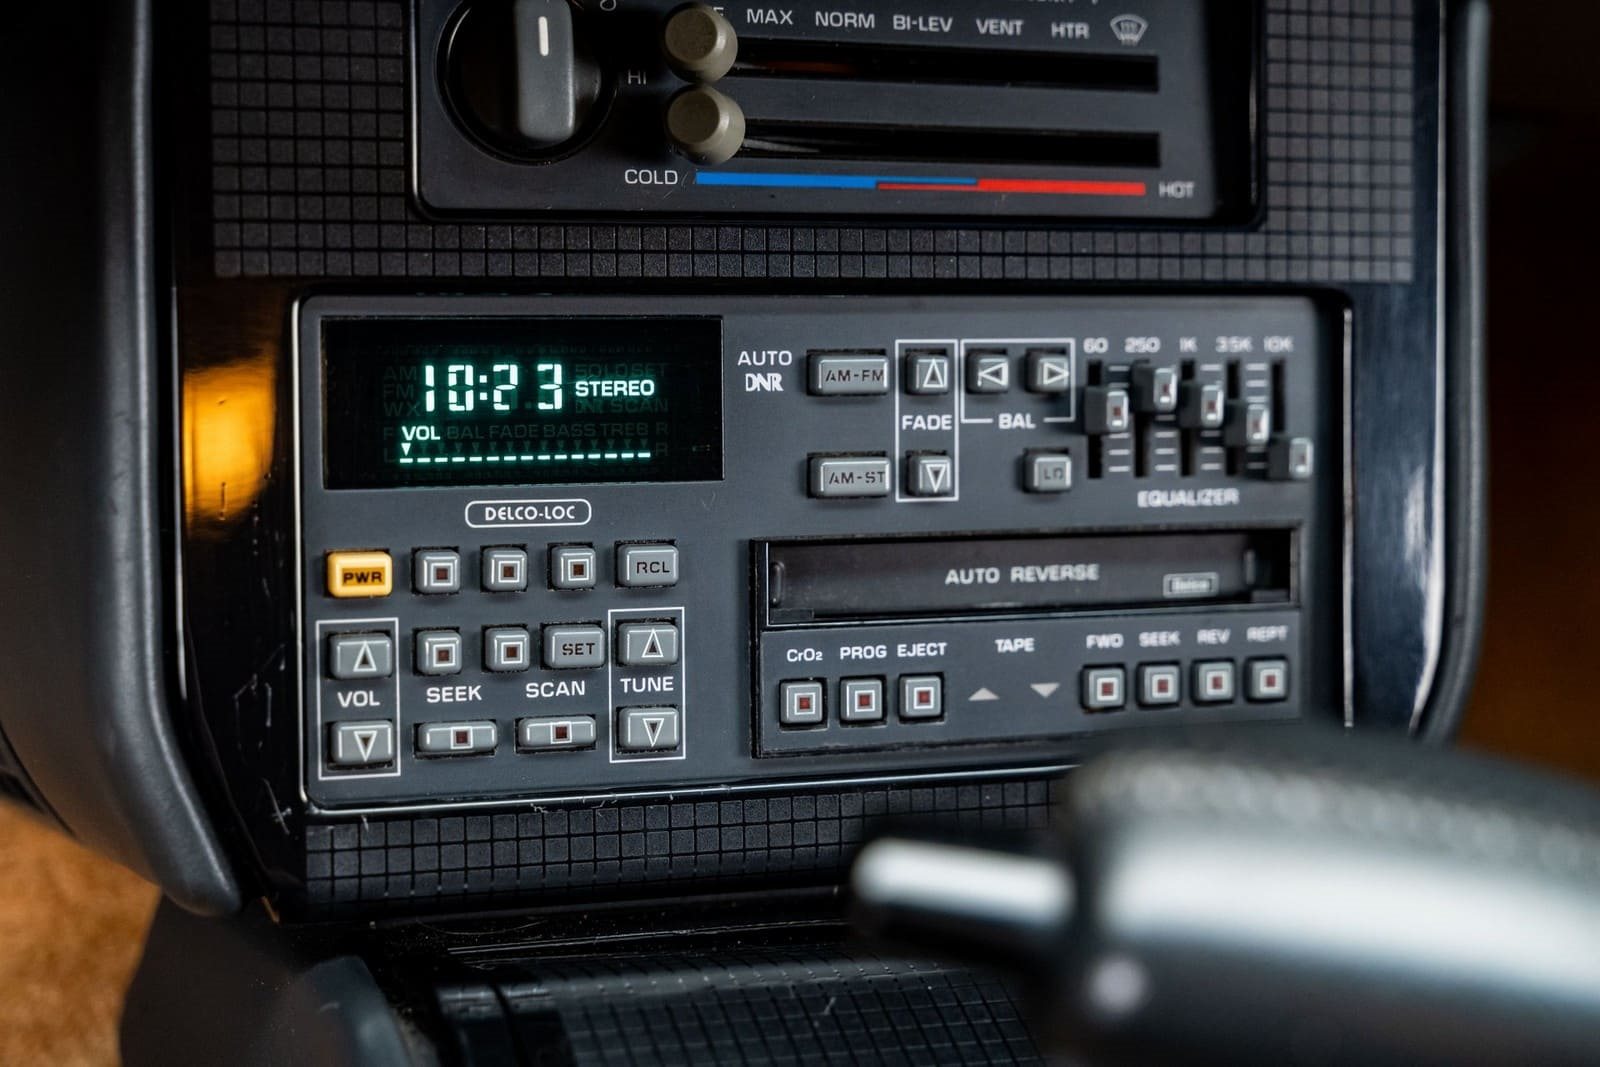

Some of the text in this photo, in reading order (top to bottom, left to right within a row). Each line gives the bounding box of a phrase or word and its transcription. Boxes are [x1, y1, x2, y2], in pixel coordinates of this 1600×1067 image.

[747, 8, 793, 25] MAX
[815, 11, 876, 29] NORM
[893, 14, 953, 33] BI-LEV
[976, 19, 1023, 36] VENT
[1051, 22, 1090, 39] HTR
[627, 71, 647, 85] HI
[624, 168, 679, 185] COLD
[1158, 181, 1195, 198] HOT
[1083, 337, 1109, 353] 60
[1124, 337, 1160, 353] 250
[1264, 336, 1293, 353] 10K
[738, 350, 793, 366] AUTO
[825, 369, 884, 382] AM-FM
[425, 363, 563, 413] 10:23
[575, 380, 655, 397] STEREO
[902, 414, 952, 431] FADE
[999, 413, 1036, 430] BAL
[402, 426, 441, 441] VOL
[828, 471, 886, 485] AM-ST
[1137, 488, 1240, 508] EQUALIZER
[484, 506, 576, 522] DELCO-LOC
[636, 560, 671, 574] RCL
[945, 563, 1099, 585] AUTO REVERSE
[343, 570, 383, 585] PWR
[1086, 633, 1124, 649] FWD
[1139, 631, 1180, 648] SEEK
[1197, 628, 1231, 645] REV
[561, 642, 596, 656] SET
[840, 644, 888, 660] PROG
[897, 642, 948, 658] EJECT
[994, 638, 1035, 653] TAPE
[525, 680, 586, 699] SCAN
[619, 676, 674, 694] TUNE
[338, 691, 381, 708] VOL
[426, 685, 482, 703] SEEK
